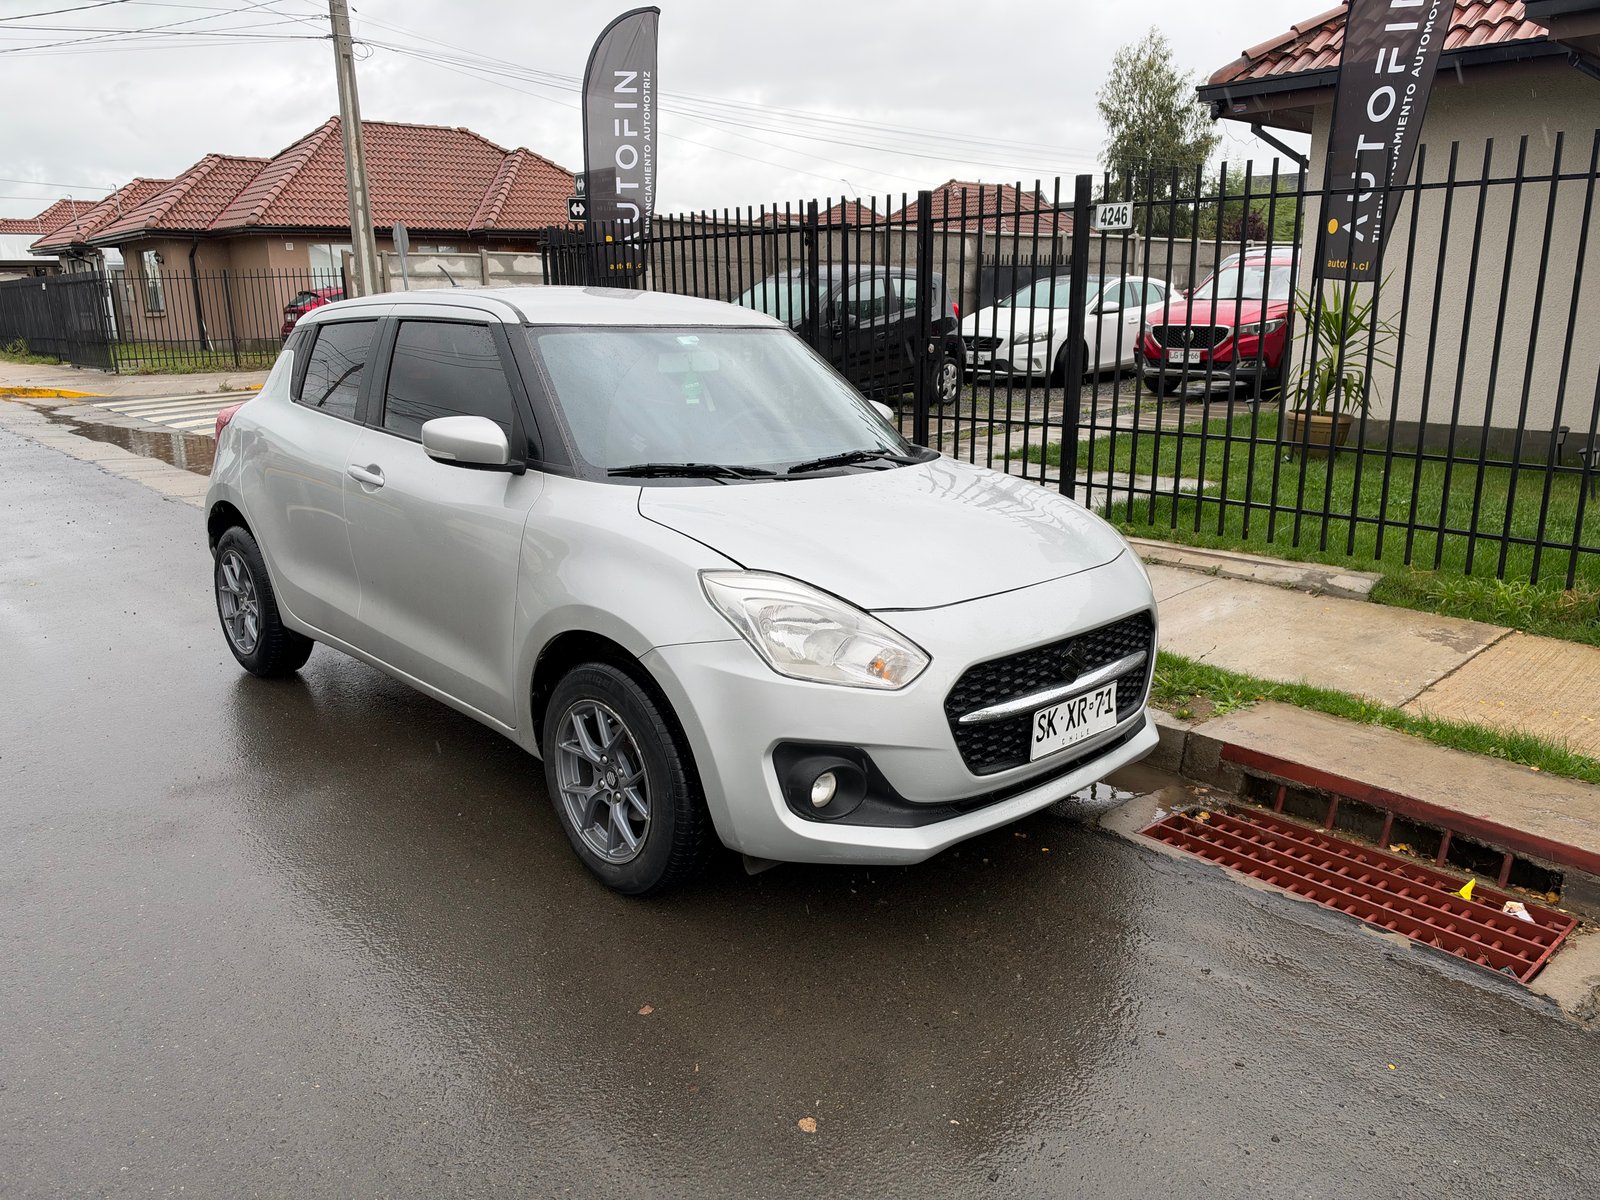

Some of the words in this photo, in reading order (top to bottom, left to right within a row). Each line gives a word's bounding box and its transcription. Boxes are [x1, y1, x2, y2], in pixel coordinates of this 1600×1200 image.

[643, 71, 651, 141] AUTOMOTRIZ
[1342, 0, 1425, 242] AUTOFI
[1100, 206, 1128, 226] 4246
